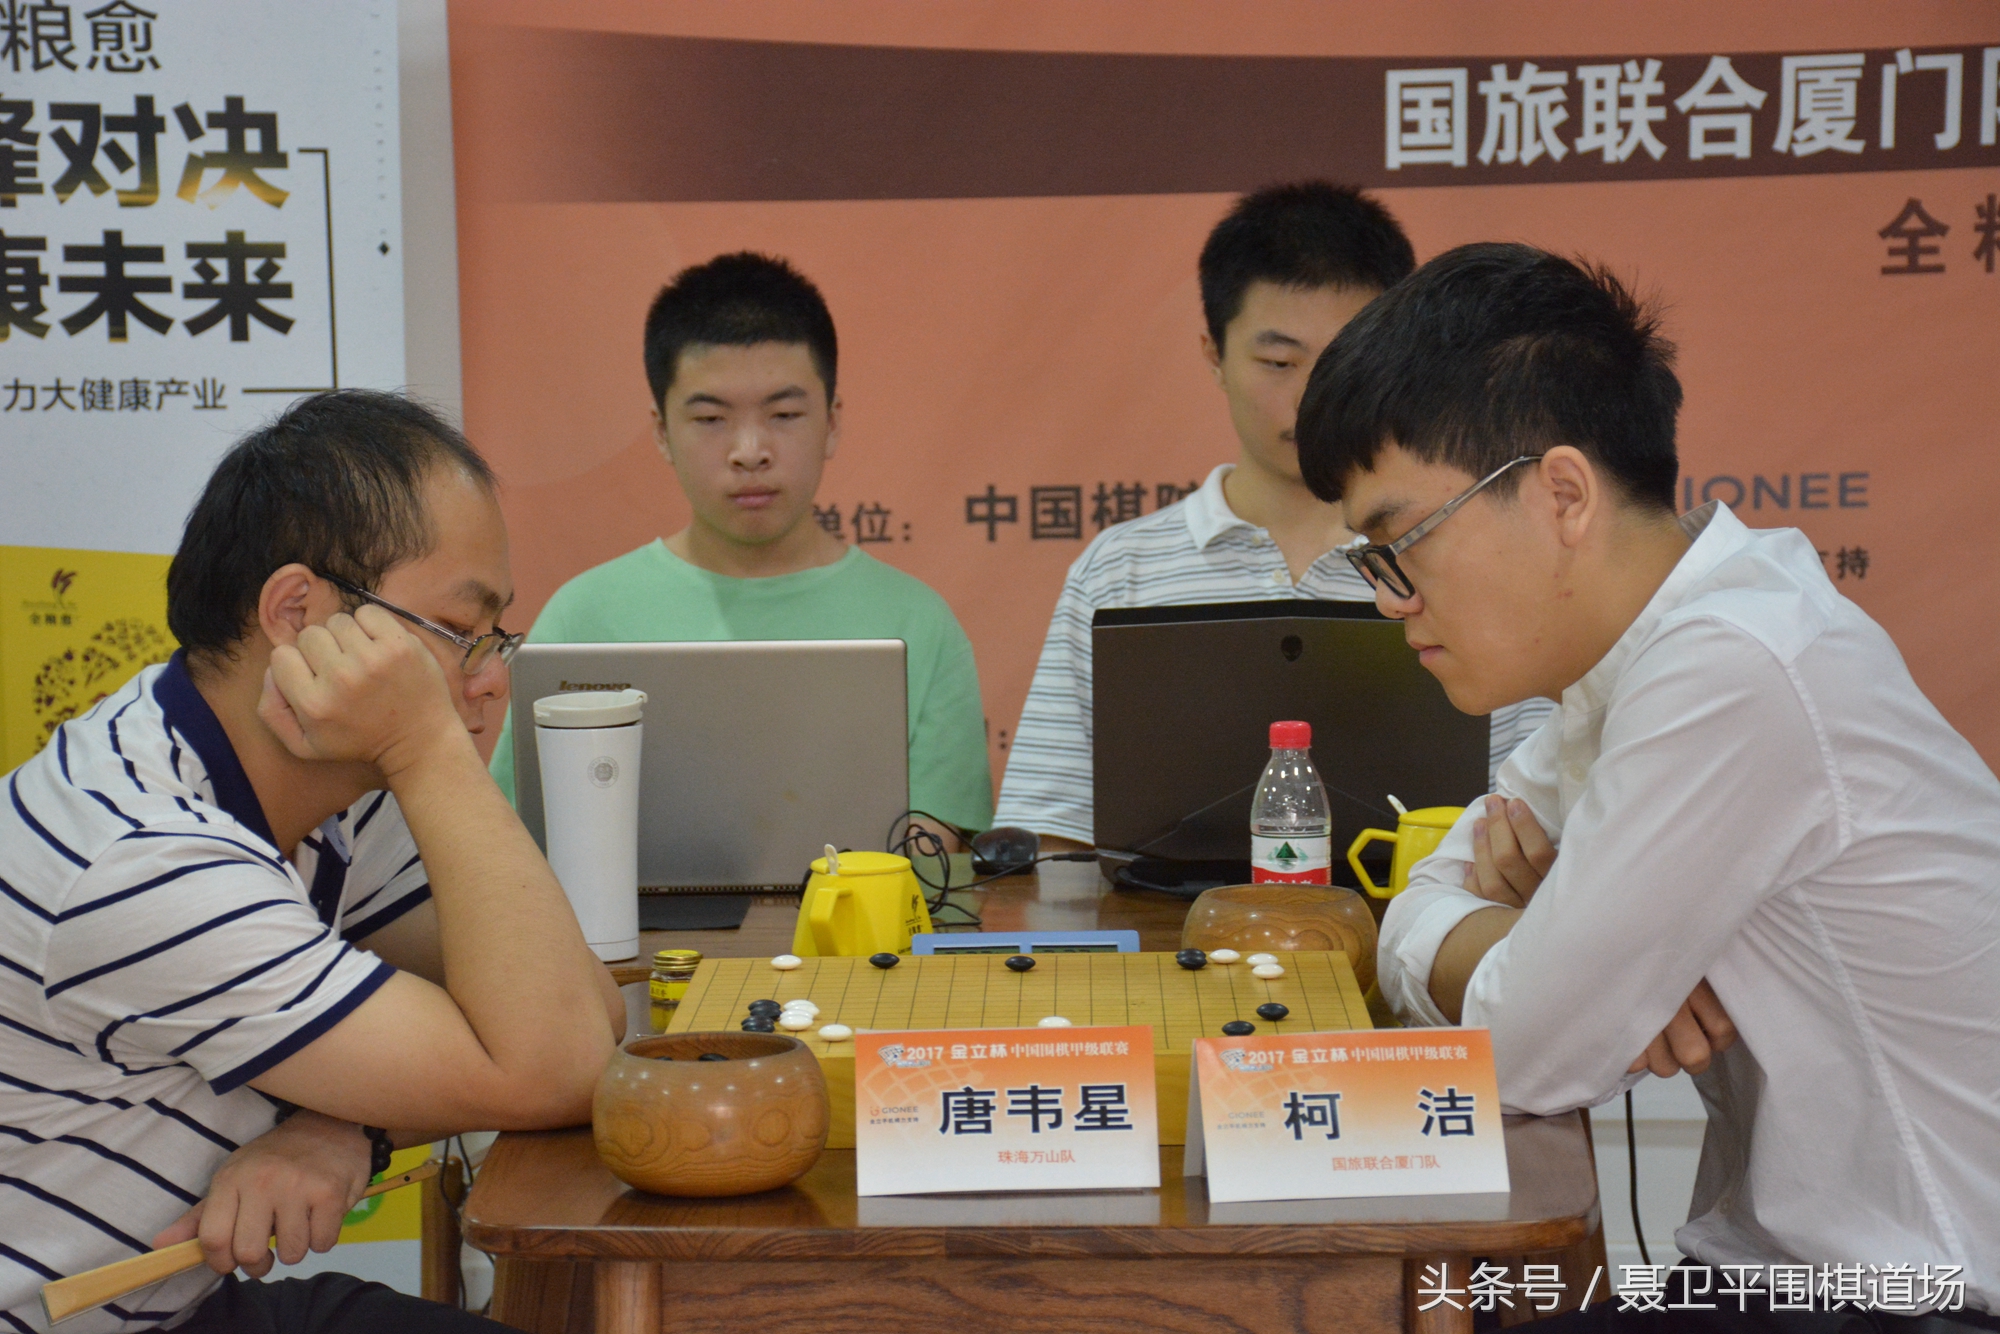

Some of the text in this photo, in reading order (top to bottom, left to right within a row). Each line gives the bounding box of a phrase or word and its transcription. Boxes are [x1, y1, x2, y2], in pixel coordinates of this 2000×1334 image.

[0, 0, 162, 73] 粮愈
[3, 377, 228, 412] 力大健康产业
[1818, 546, 1869, 580] 持
[906, 1041, 1129, 1061] 2017 金立杯 中国围棋甲级联赛
[1248, 1045, 1468, 1065] 2017 金立杯 中国围棋甲级联赛
[938, 1084, 1133, 1135] 唐韦星
[997, 1149, 1076, 1164] 珠海万山队
[1331, 1154, 1441, 1171] 国旅联合厦门队
